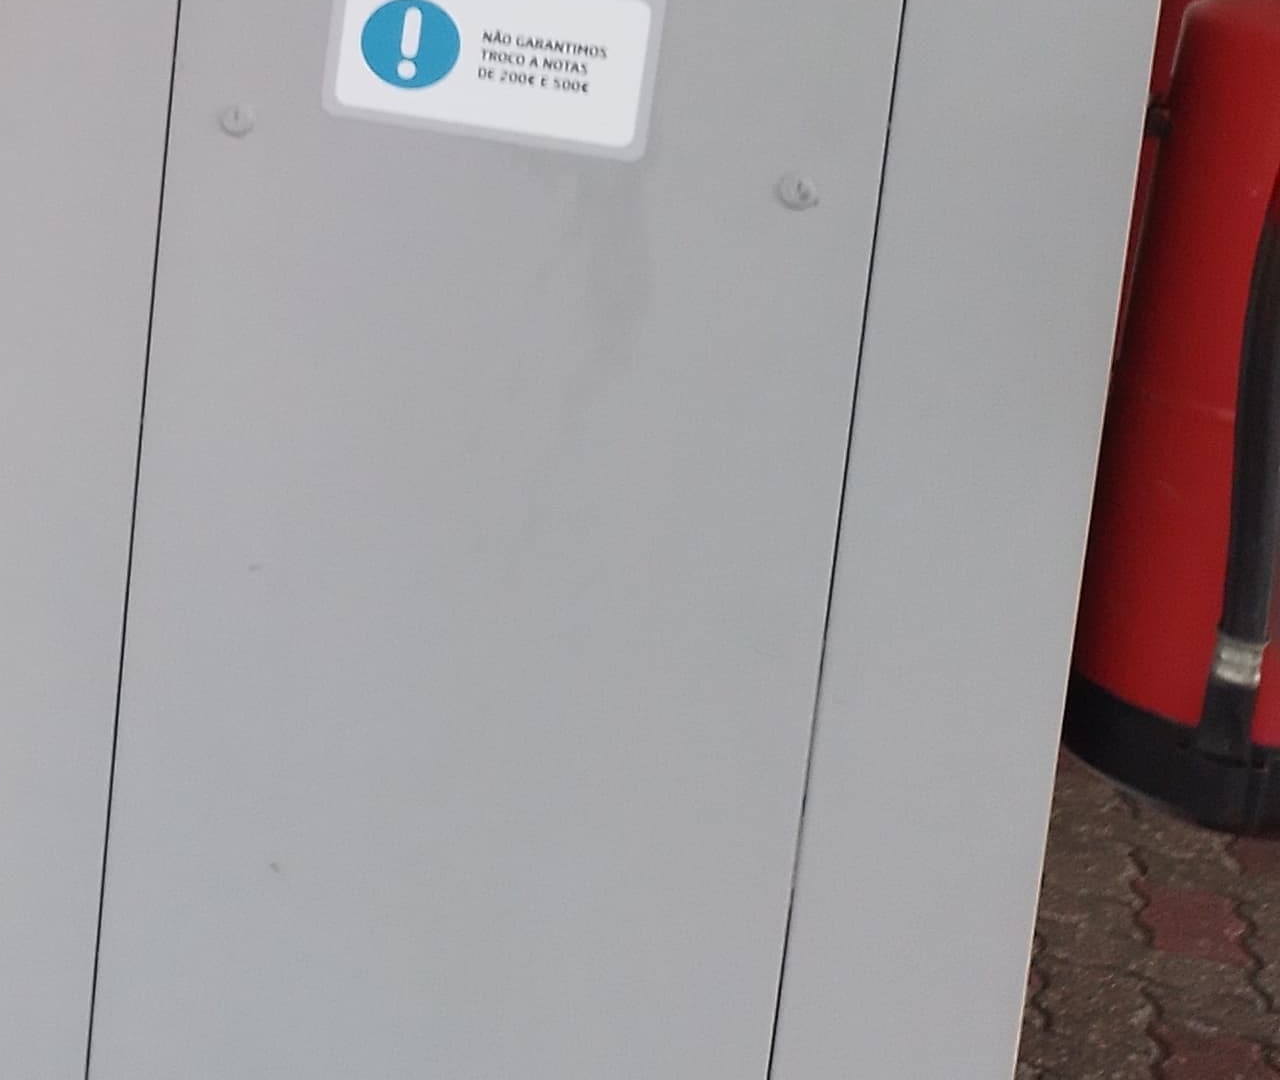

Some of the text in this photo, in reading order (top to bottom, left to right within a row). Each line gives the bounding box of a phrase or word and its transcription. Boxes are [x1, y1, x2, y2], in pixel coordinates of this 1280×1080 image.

[482, 29, 608, 59] NÃO GARANTIMOS
[478, 67, 494, 80] DE
[481, 49, 589, 76] TROCO A NOTAS
